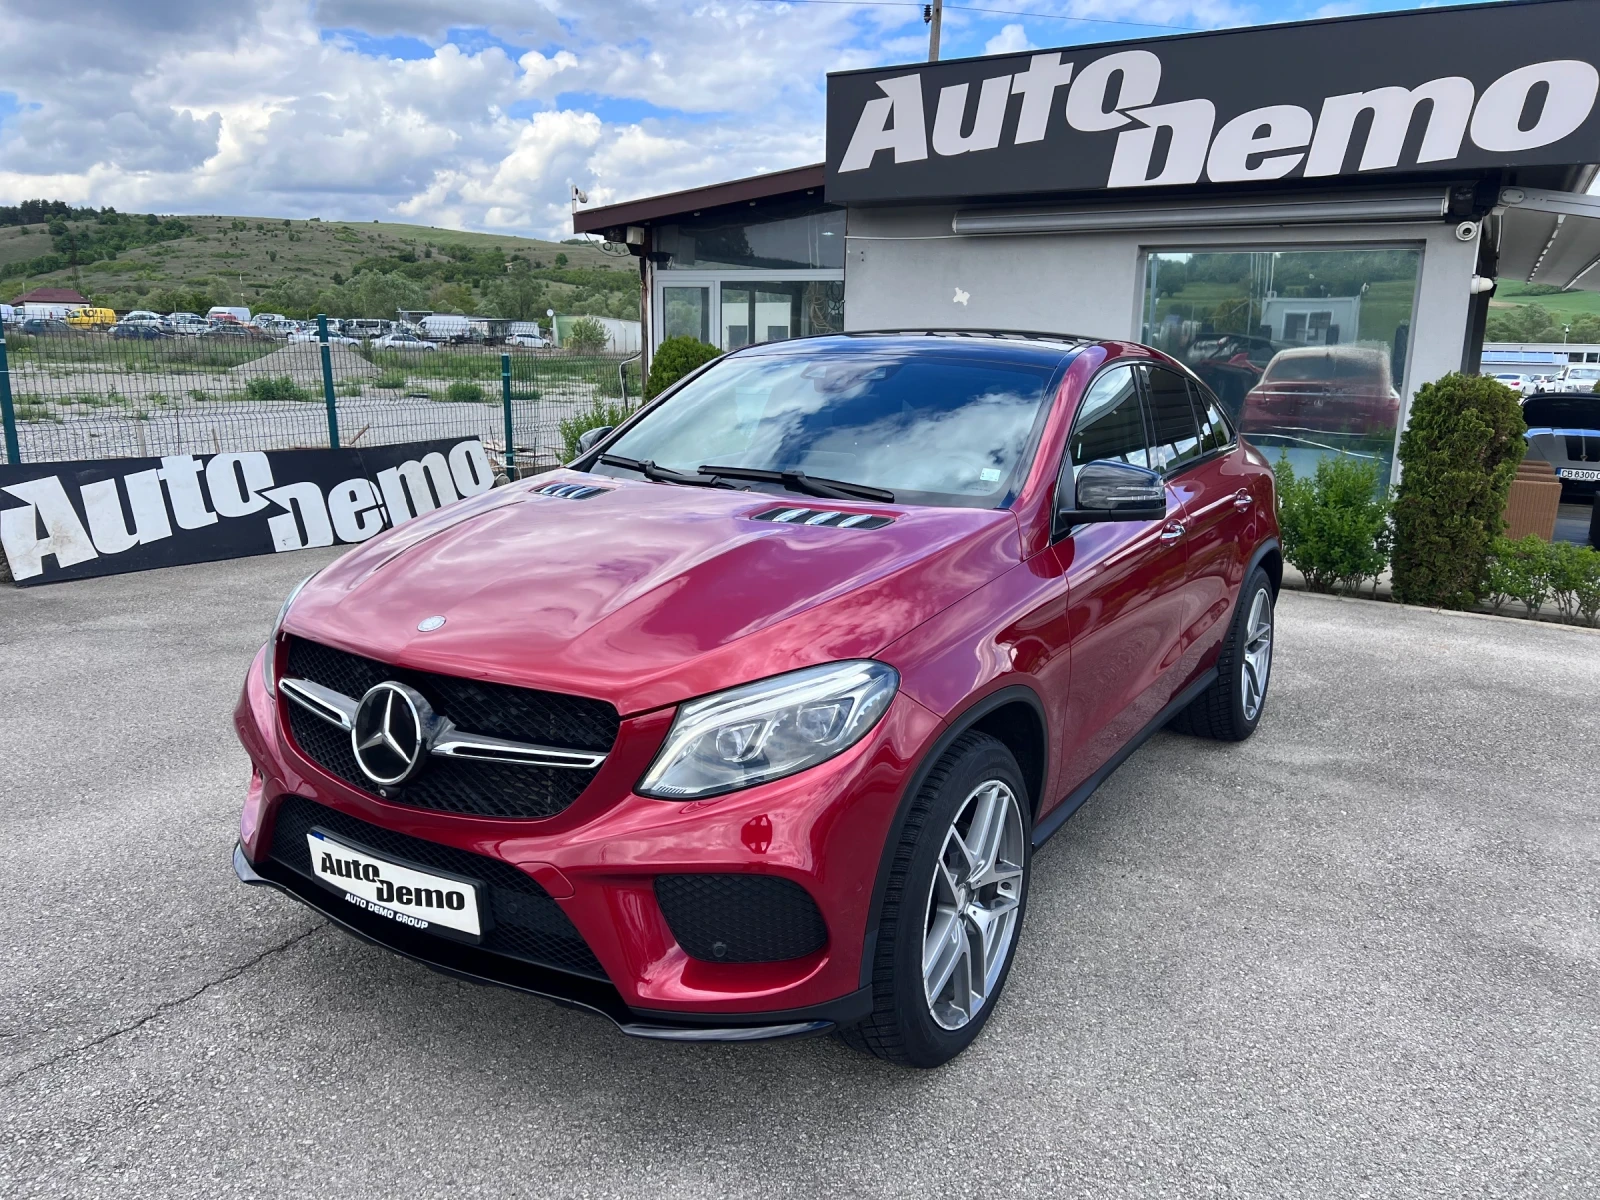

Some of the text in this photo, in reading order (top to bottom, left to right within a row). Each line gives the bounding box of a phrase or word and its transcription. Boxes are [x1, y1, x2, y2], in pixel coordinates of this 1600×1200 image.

[838, 50, 1600, 188] Auto Demo
[1562, 470, 1573, 478] CB
[1574, 471, 1595, 479] 8300
[0, 440, 495, 581] Auto Demo
[321, 852, 465, 911] Auto Demo
[344, 893, 429, 930] AUTO DEMO GROUP
